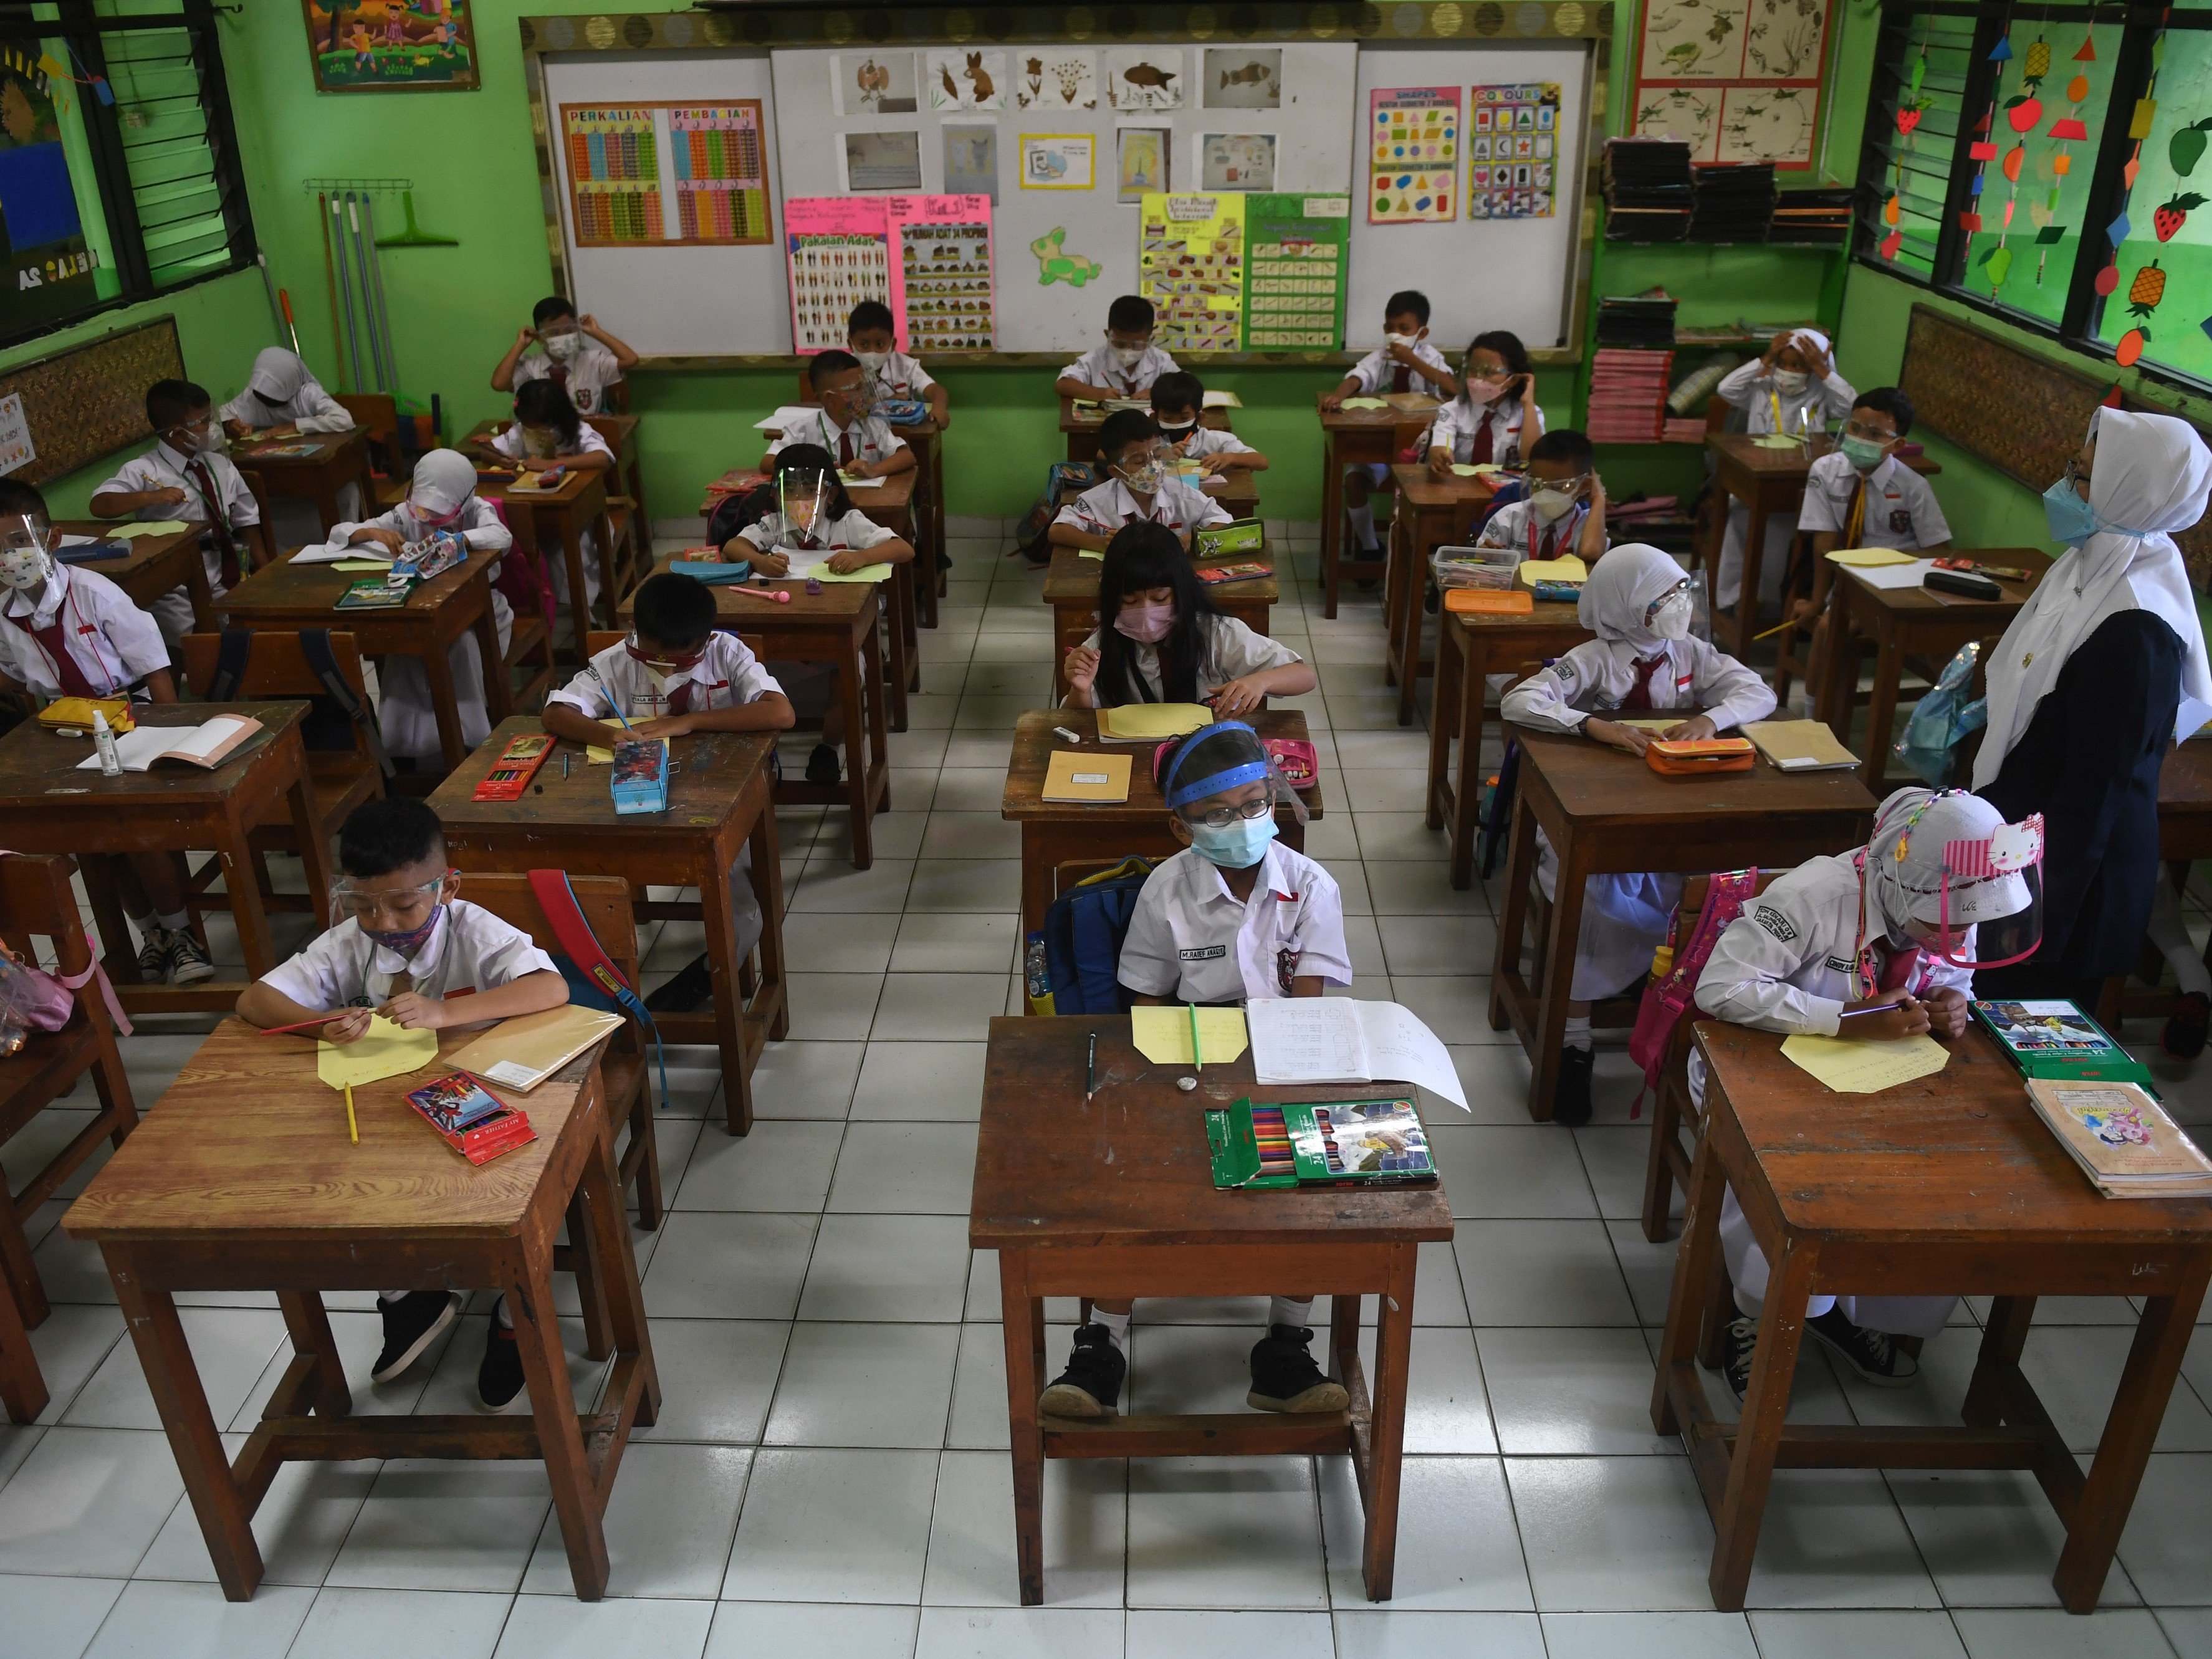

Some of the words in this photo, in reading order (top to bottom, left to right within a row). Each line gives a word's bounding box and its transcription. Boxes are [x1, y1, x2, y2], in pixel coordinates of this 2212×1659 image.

[1475, 88, 1540, 102] COLOURS
[570, 110, 651, 122] PERKALIAN
[674, 109, 749, 119] PEMBAGIAN
[801, 234, 845, 247] Pakaian
[846, 234, 876, 246] Adat
[1769, 912, 1787, 927] KENARI
[1829, 960, 1845, 970] CINDY
[1313, 1156, 1323, 1164] 24
